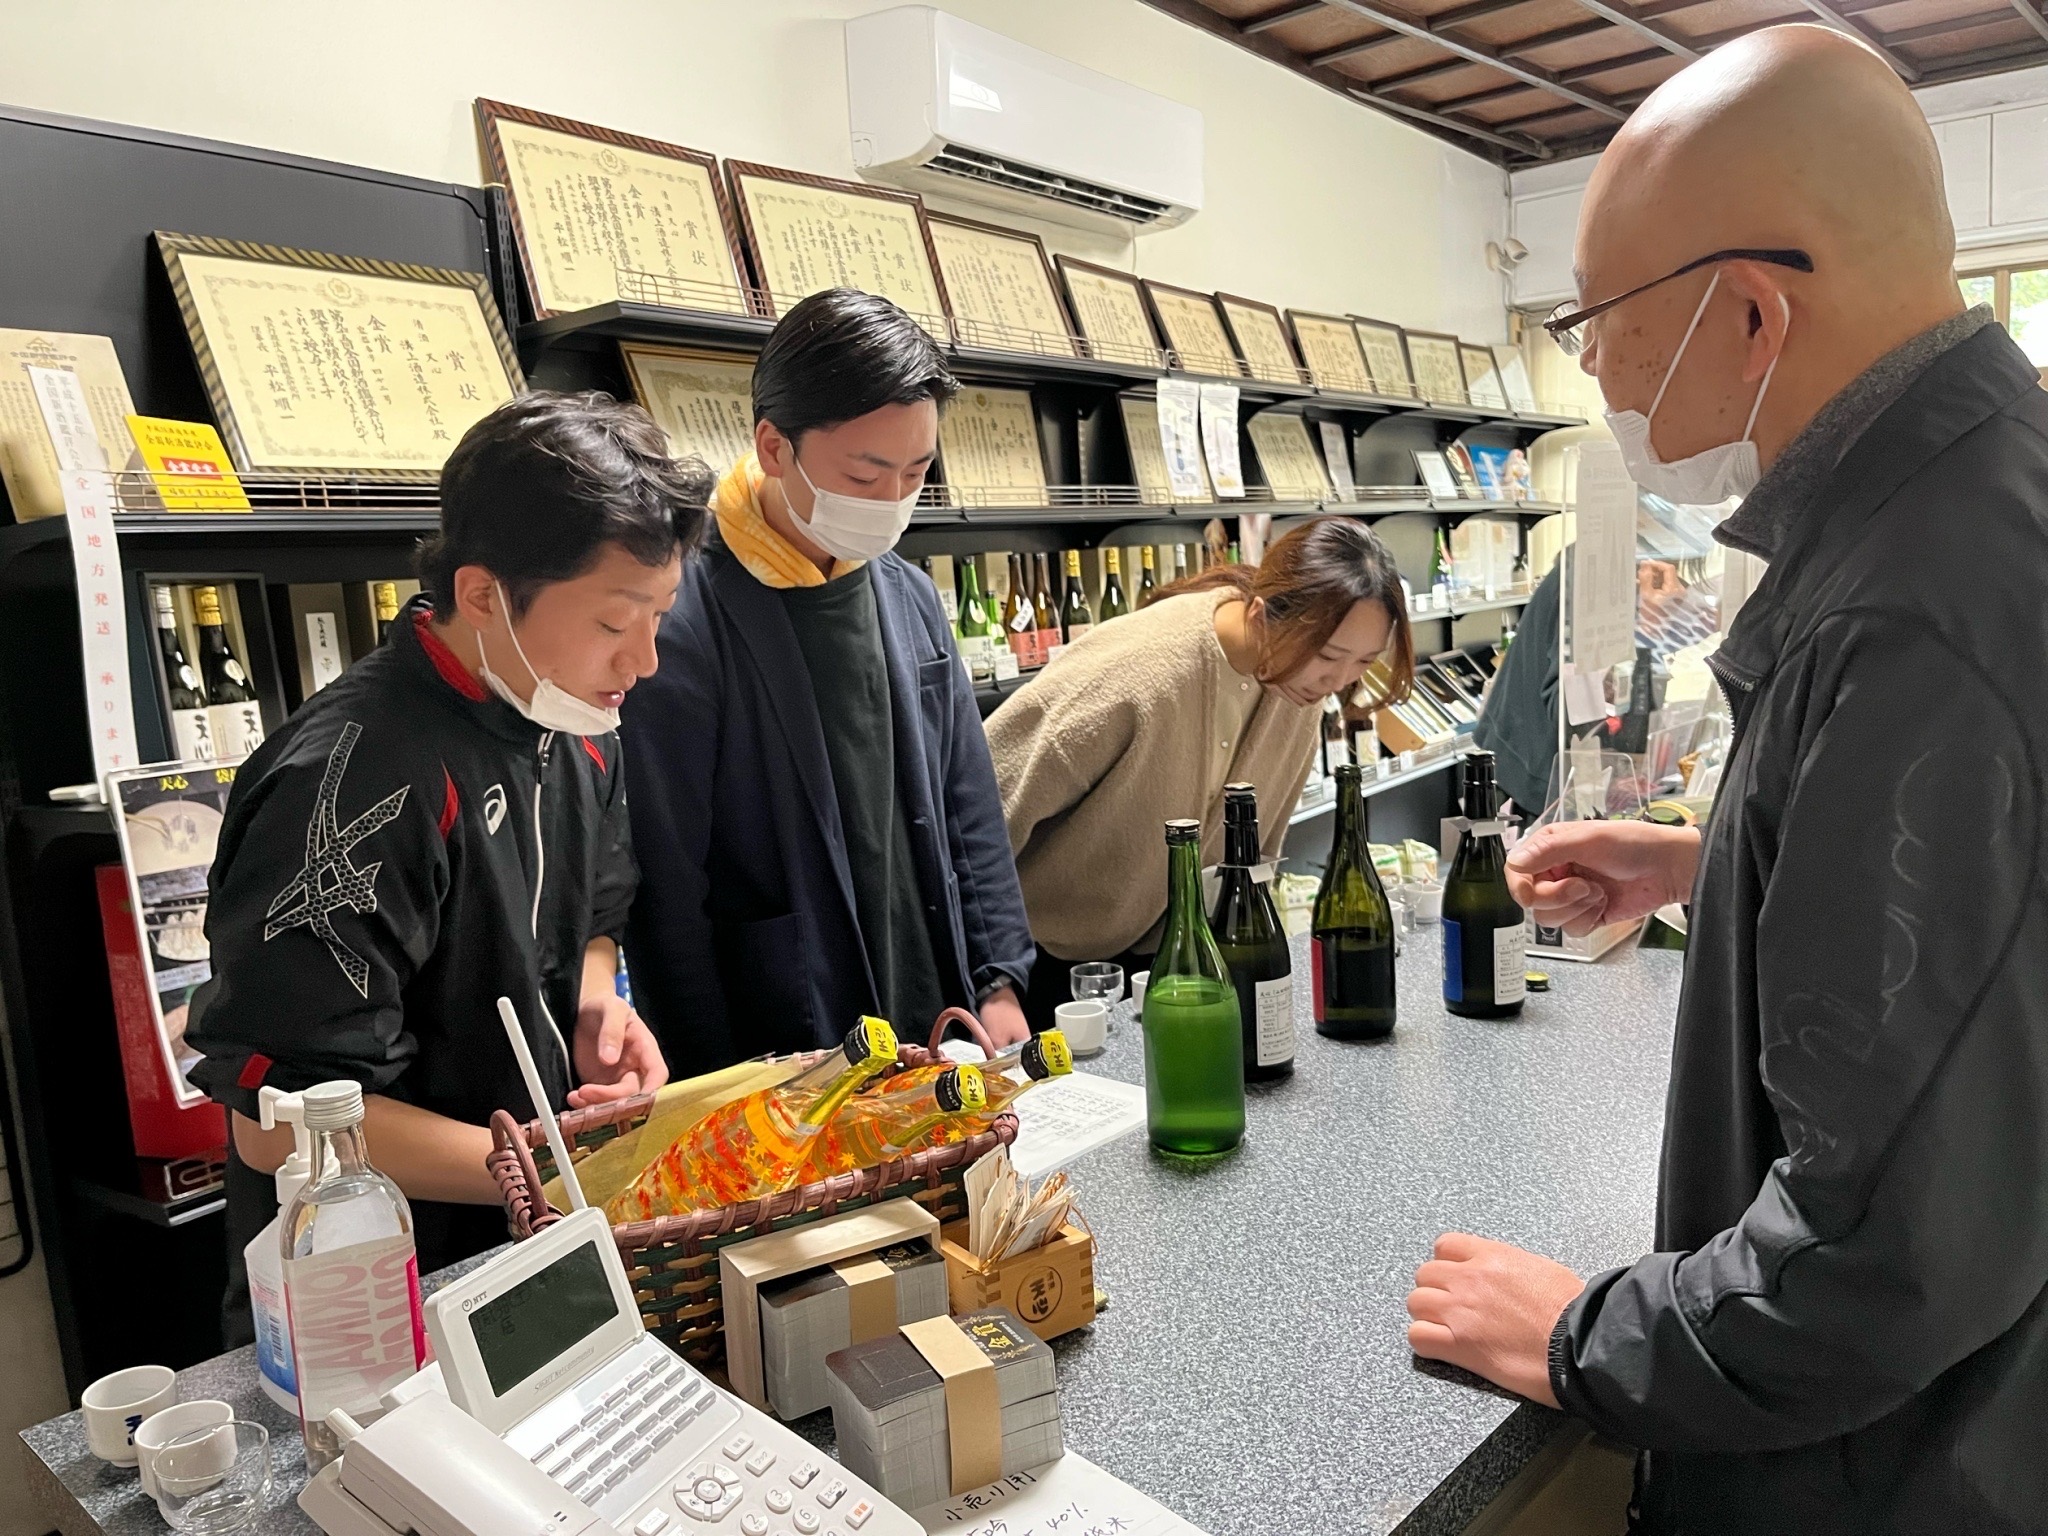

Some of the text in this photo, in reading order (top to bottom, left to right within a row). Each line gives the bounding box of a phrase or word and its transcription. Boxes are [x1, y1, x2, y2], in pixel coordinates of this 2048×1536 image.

[628, 183, 646, 220] 金賞
[683, 219, 708, 267] 賞状
[847, 223, 863, 255] 金賞
[892, 252, 915, 293] 賞状
[367, 313, 393, 354] 金賞
[263, 363, 296, 420] 平松順一
[445, 349, 481, 401] 賞状
[75, 475, 111, 636] 全国地方発送
[100, 670, 122, 766] 承ります
[159, 774, 189, 792] 天心
[471, 1290, 489, 1305] NTT
[770, 1488, 784, 1501] 3
[824, 1481, 843, 1500] スピーカ
[946, 1471, 1038, 1523] 小売り用
[745, 1512, 760, 1526] 2
[799, 1508, 811, 1521] 6
